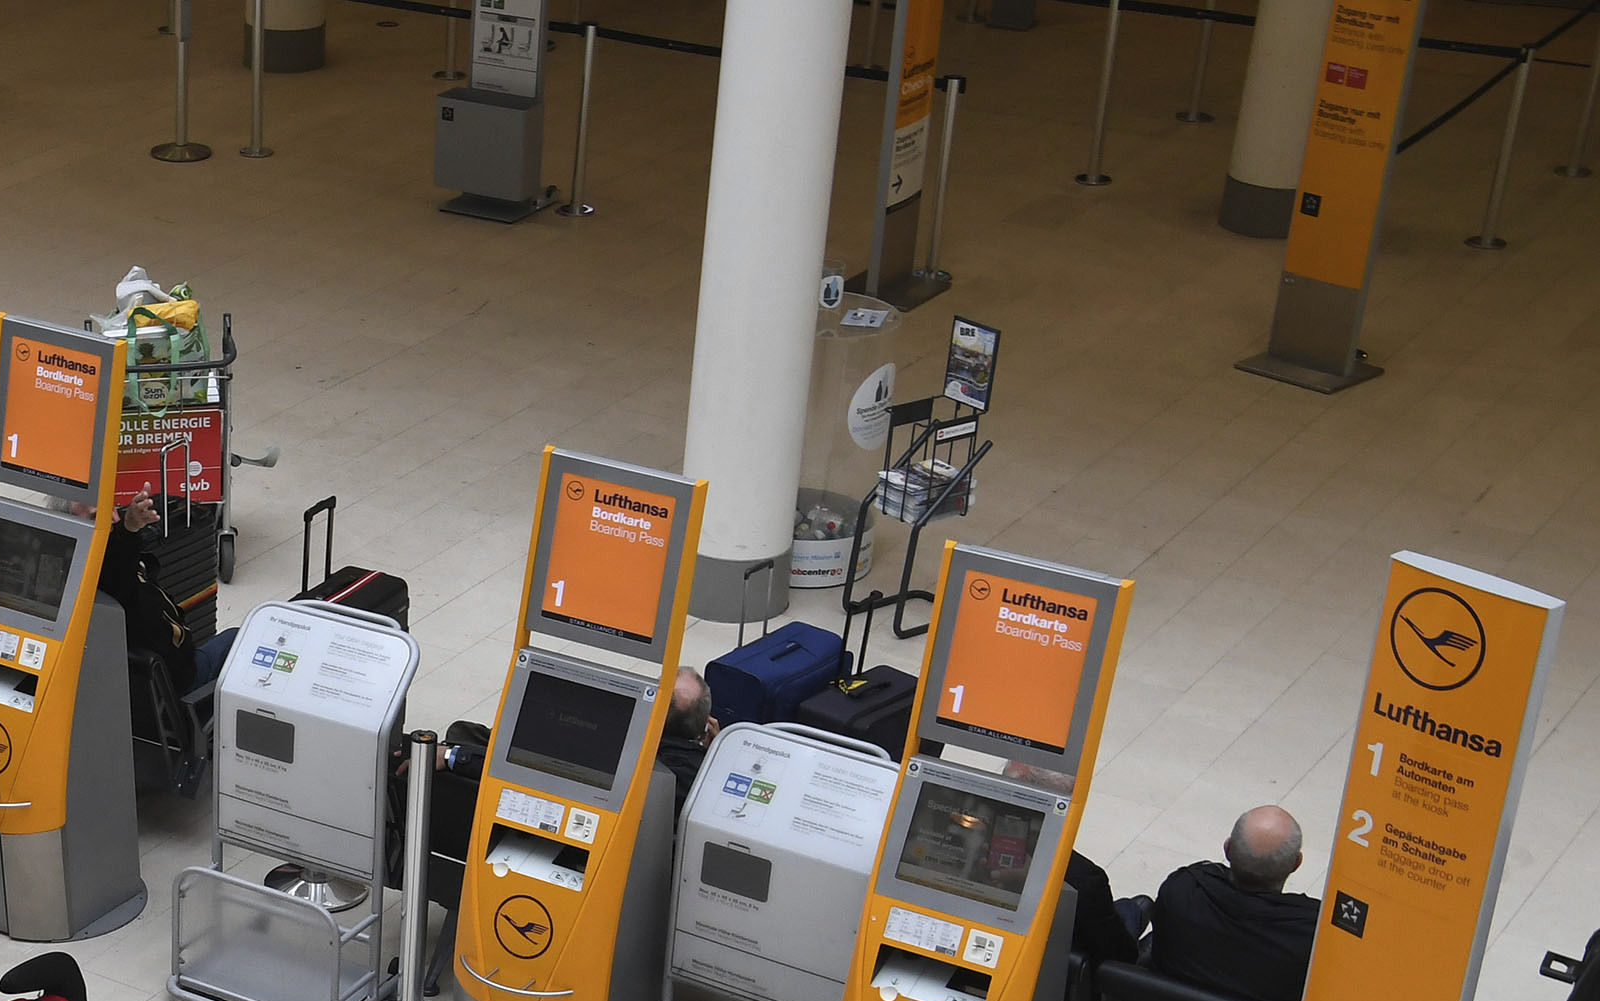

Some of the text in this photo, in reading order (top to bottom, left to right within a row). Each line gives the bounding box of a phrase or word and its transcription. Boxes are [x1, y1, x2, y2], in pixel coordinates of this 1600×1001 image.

[959, 327, 976, 337] BRE
[36, 366, 84, 387] Bordkarte
[37, 350, 97, 376] Lufthansa
[34, 378, 95, 402] Boarding Pass
[120, 417, 211, 432] OLLE ENERGIE
[136, 431, 193, 445] BREMEN
[7, 433, 19, 458] 1
[179, 478, 211, 493] swb
[592, 505, 652, 530] Bordkarte
[594, 488, 669, 519] Lufthansa
[589, 519, 665, 548] Boarding Pass
[791, 567, 831, 576] obcenter
[551, 579, 565, 607] 1
[1001, 588, 1089, 621] Lufthansa
[568, 618, 617, 636] STAR ALLIANCE
[999, 606, 1068, 633] Bordkarte
[995, 621, 1083, 652] Boarding Pass
[949, 684, 964, 714] 1
[968, 725, 1024, 746] STAR ALLIANCE
[1373, 691, 1502, 759] Lufthansa
[1367, 741, 1384, 777] 1
[1399, 752, 1475, 788] Bordkarte am
[1396, 765, 1456, 794] Automaten
[1392, 790, 1449, 818] at the kiosk
[1394, 776, 1470, 813] Boarding pass
[1347, 809, 1374, 848] 2
[1385, 822, 1467, 862] Gepäckabgabe
[1382, 835, 1448, 867] am Schalter
[1377, 858, 1448, 892] at the counter
[1379, 846, 1471, 888] Baggage drop off
